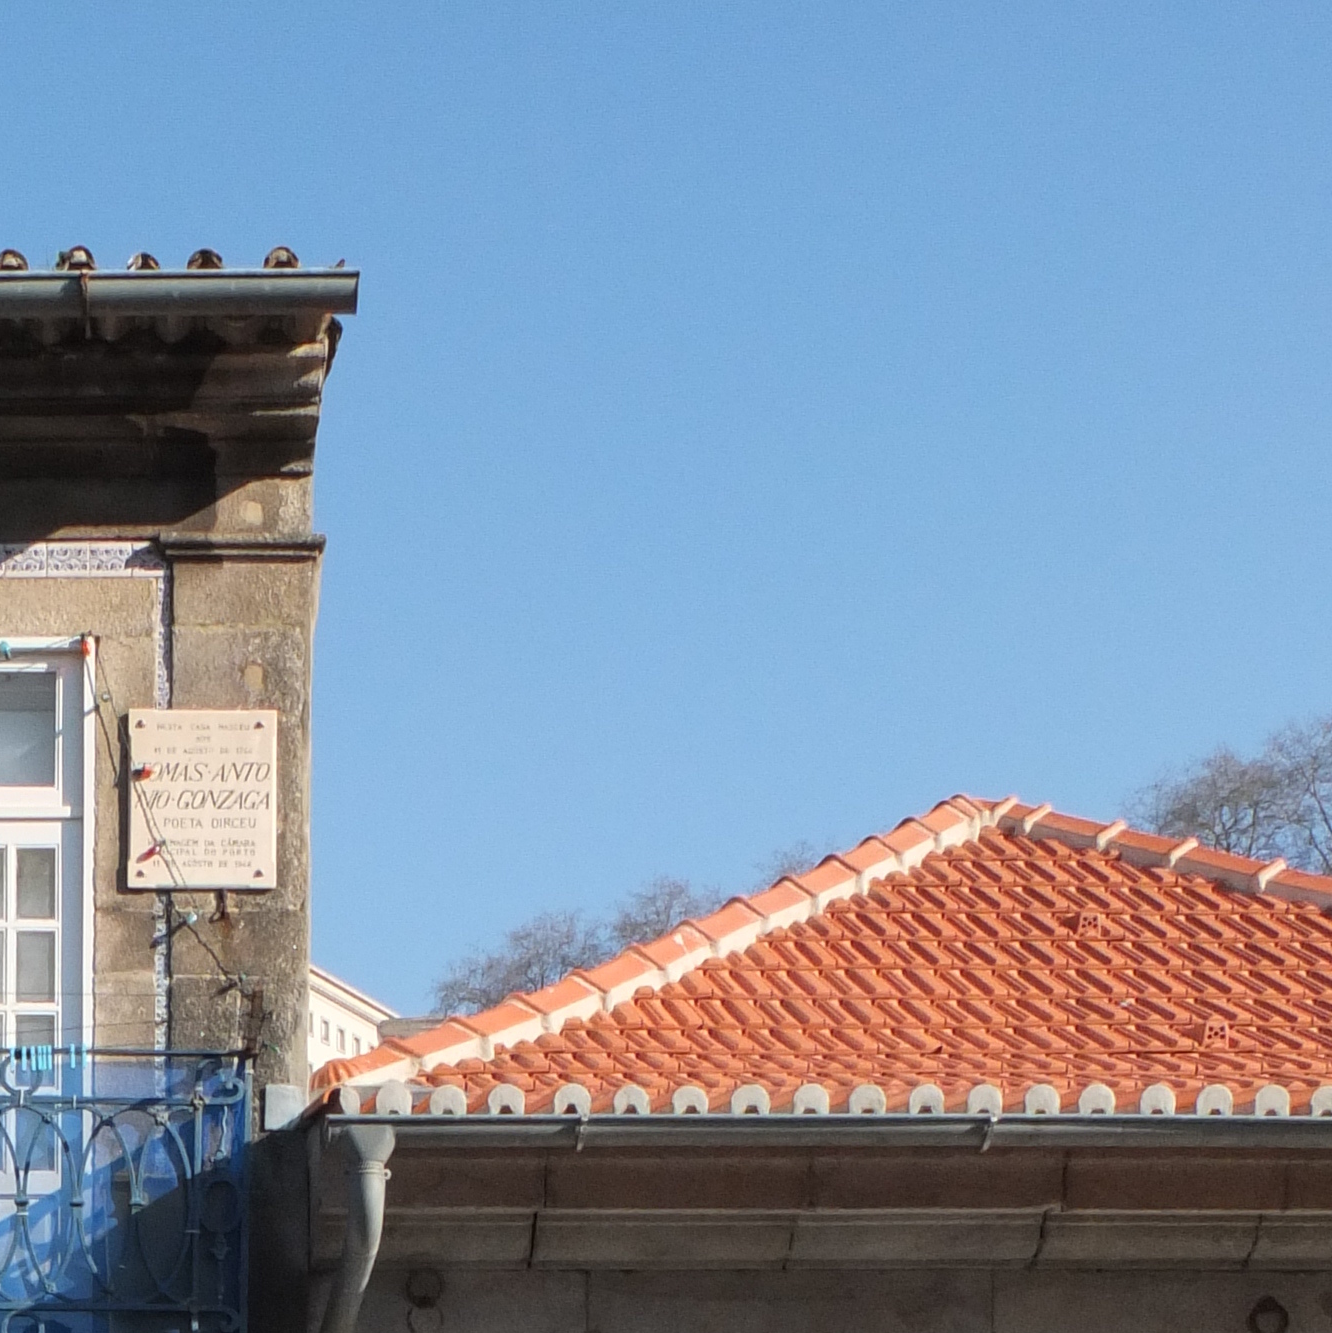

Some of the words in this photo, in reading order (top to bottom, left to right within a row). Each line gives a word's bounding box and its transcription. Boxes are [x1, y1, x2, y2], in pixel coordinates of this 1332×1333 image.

[176, 789, 270, 810] GONZAGA
[163, 817, 203, 829] POETA
[211, 817, 257, 829] DIRCEU
